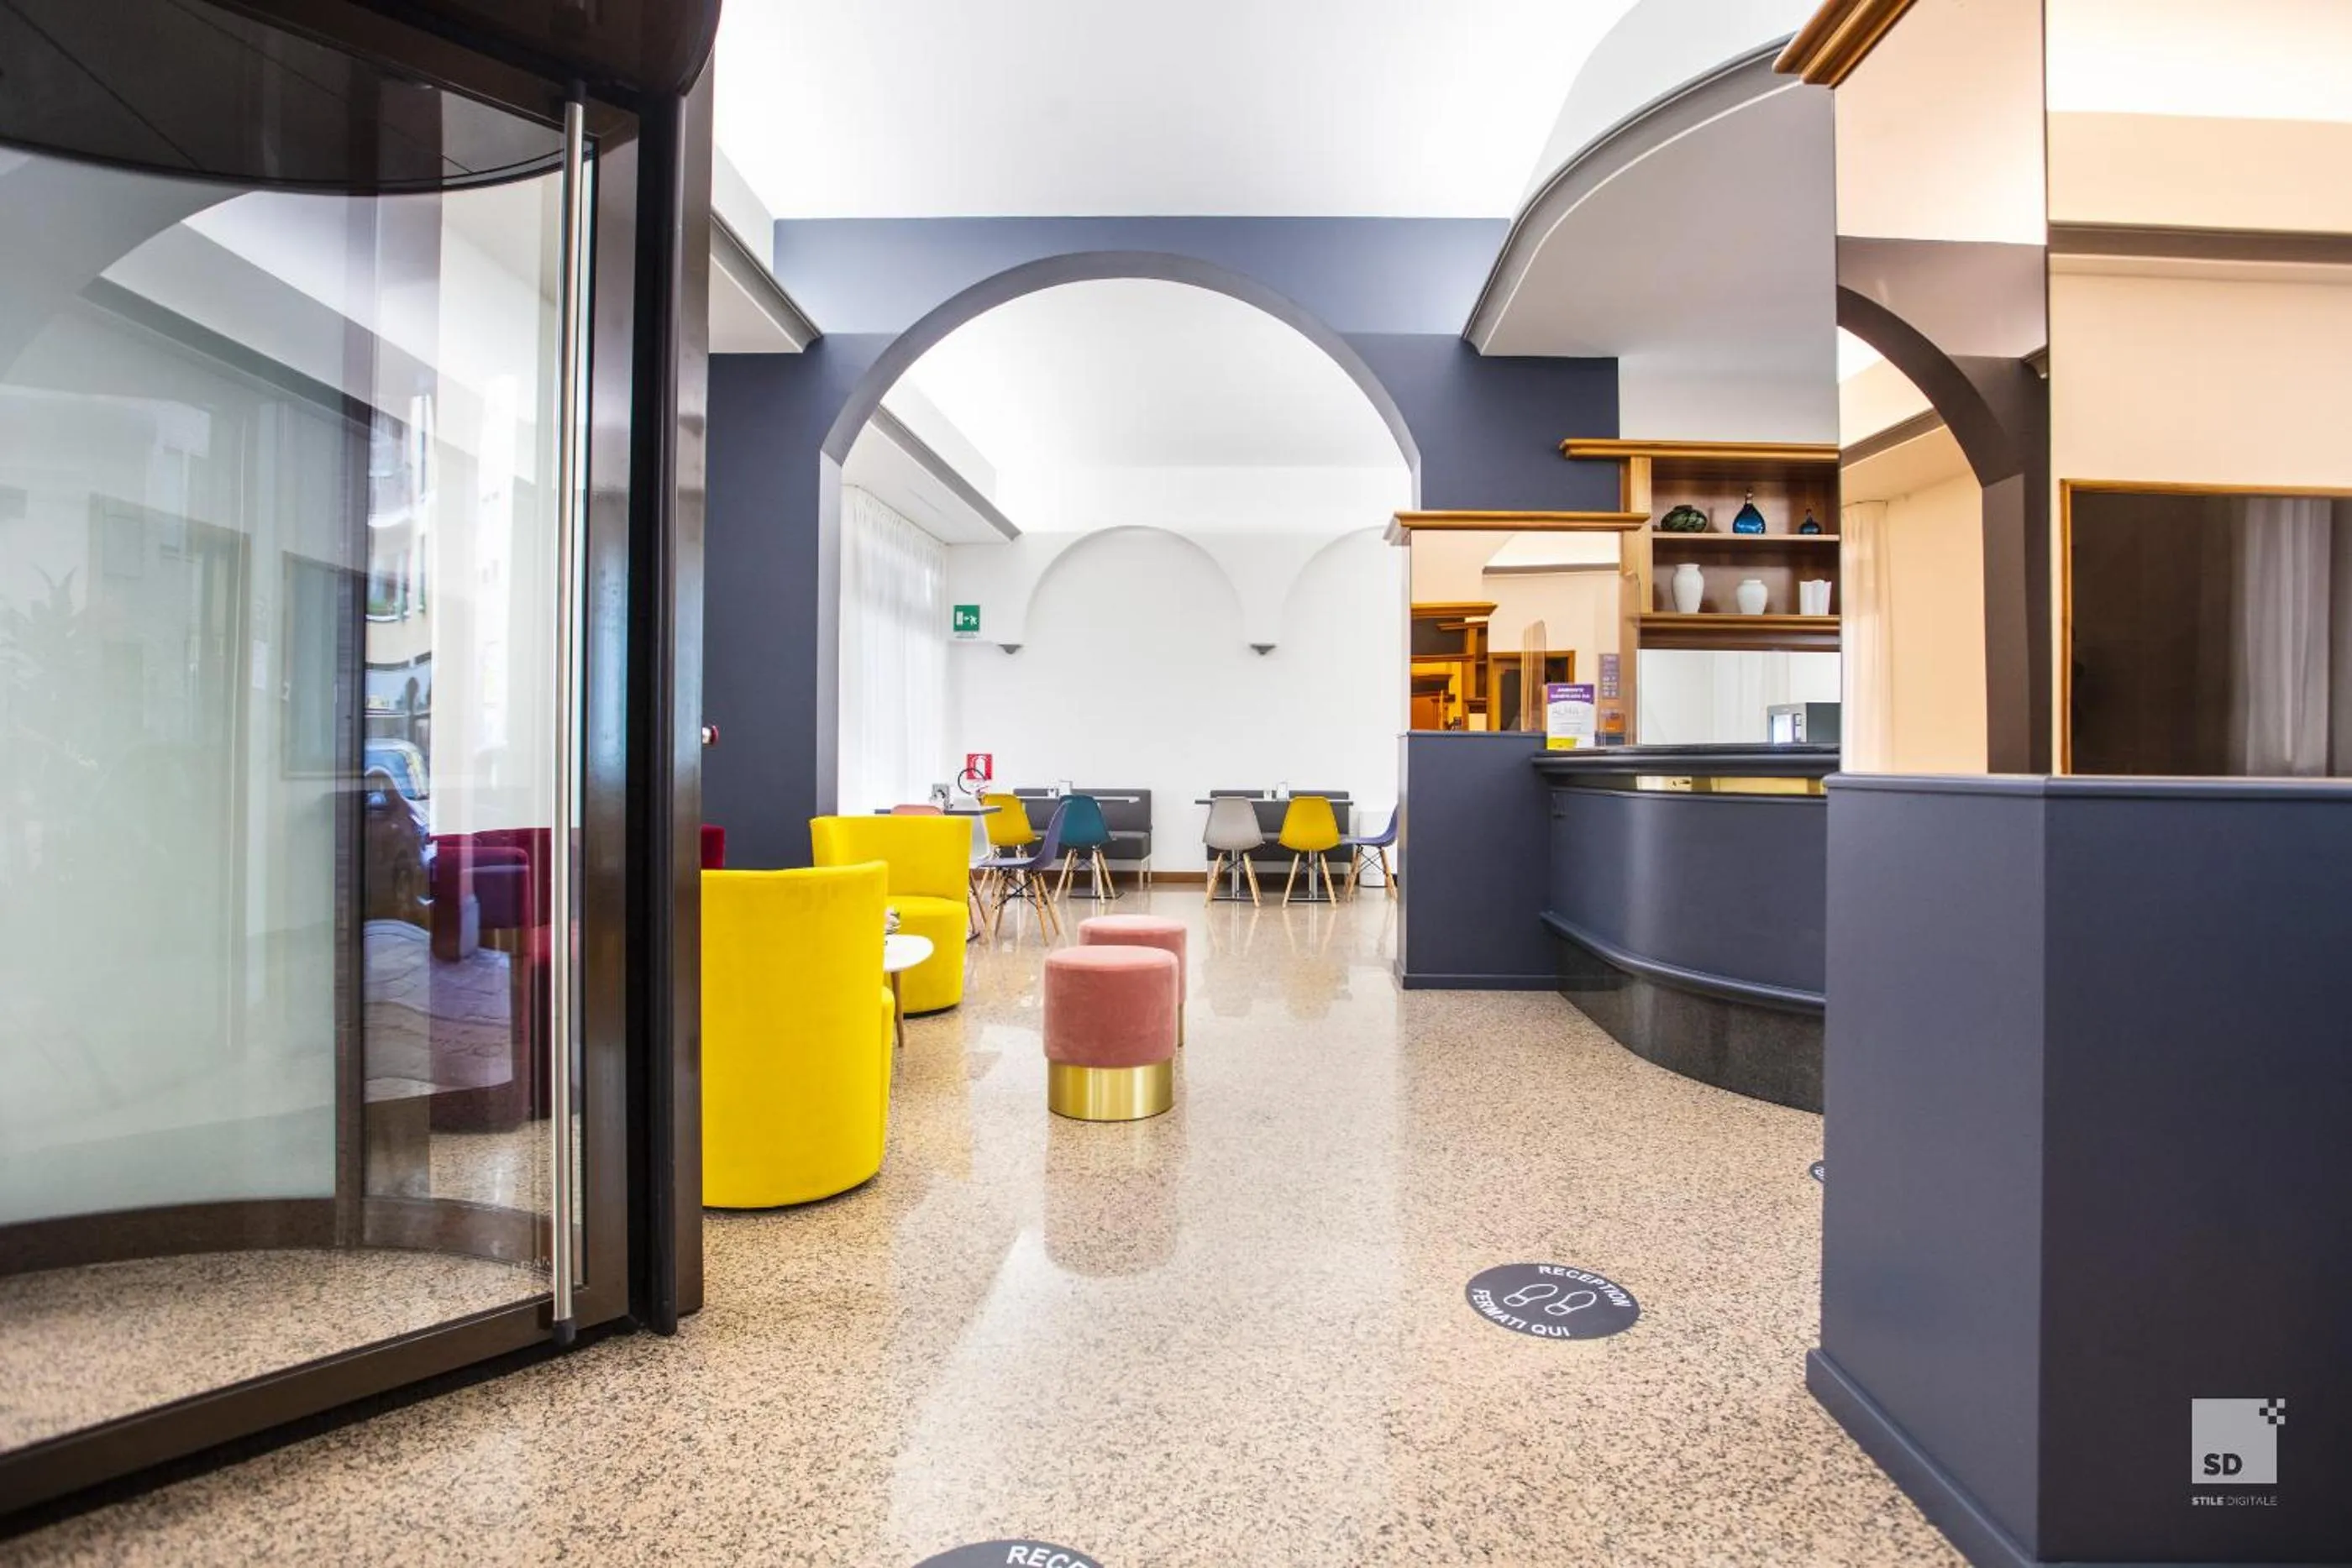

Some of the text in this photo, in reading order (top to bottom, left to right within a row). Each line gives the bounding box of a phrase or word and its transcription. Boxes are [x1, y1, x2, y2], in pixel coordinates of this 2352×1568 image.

[1539, 1266, 1631, 1308] RECEPTION
[1472, 1287, 1570, 1337] FERMATI QUI
